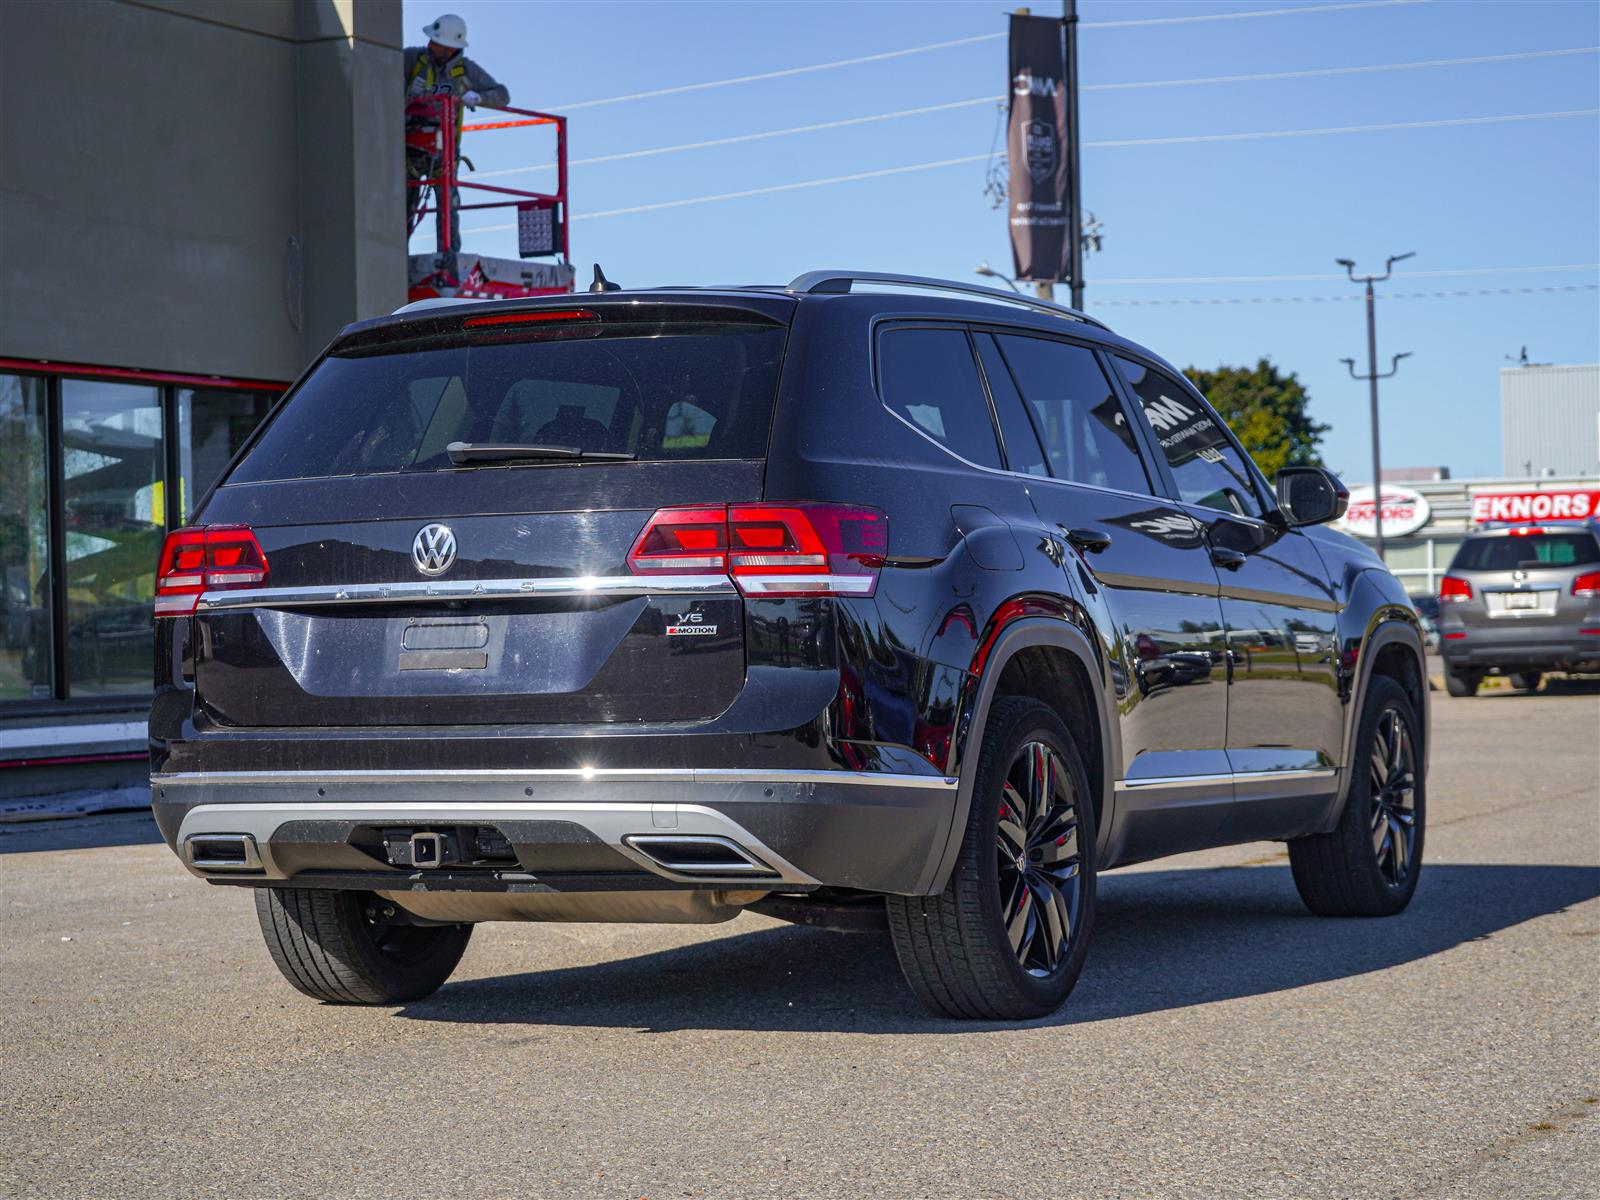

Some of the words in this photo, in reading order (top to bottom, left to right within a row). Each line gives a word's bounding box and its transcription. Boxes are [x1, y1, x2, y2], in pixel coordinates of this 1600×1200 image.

[1473, 494, 1590, 519] EKNORS
[335, 581, 536, 600] ATLAS
[677, 613, 703, 624] V6
